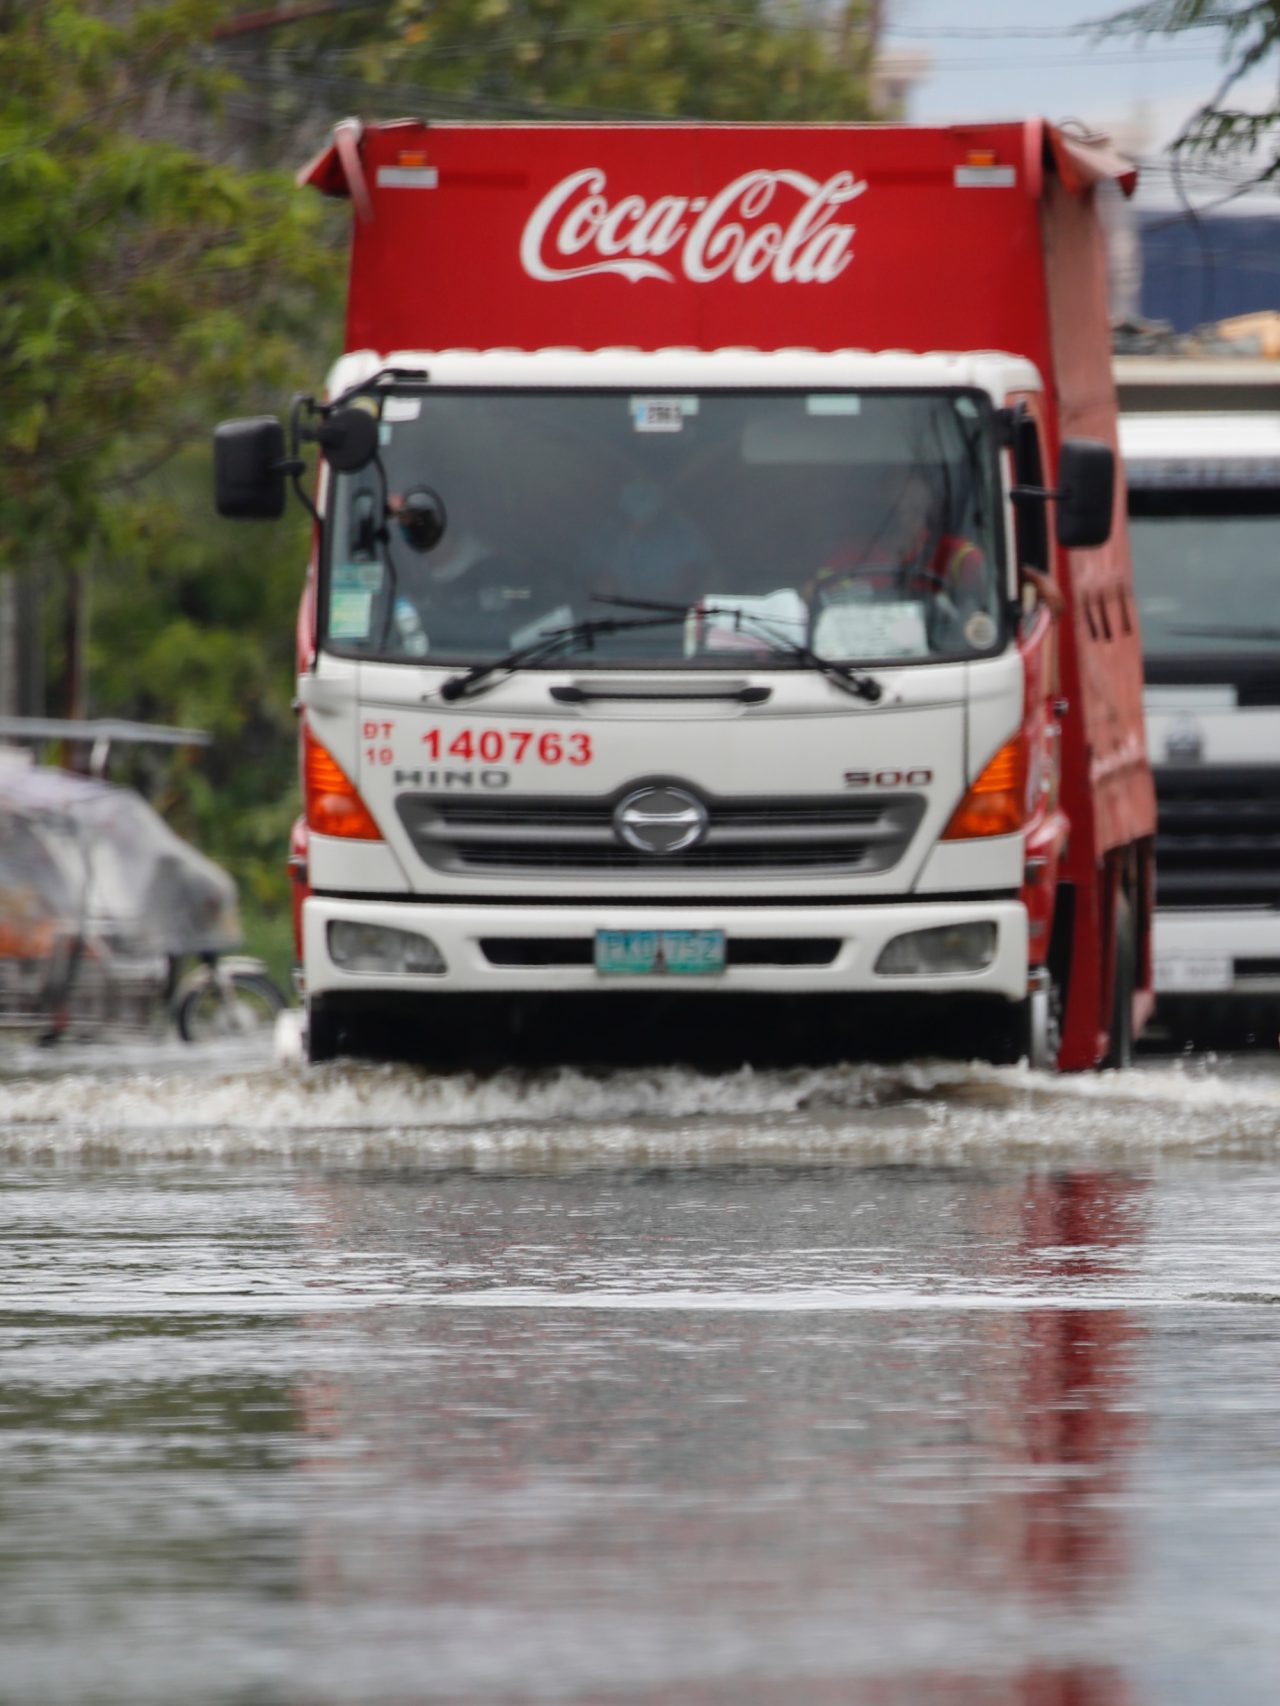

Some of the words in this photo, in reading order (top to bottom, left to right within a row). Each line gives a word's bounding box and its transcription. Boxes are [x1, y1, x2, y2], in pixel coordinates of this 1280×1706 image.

[520, 167, 868, 283] Coca-Cola
[363, 722, 394, 739] DT
[422, 729, 593, 765] 140763
[394, 769, 509, 787] HINO
[844, 769, 933, 788] 500
